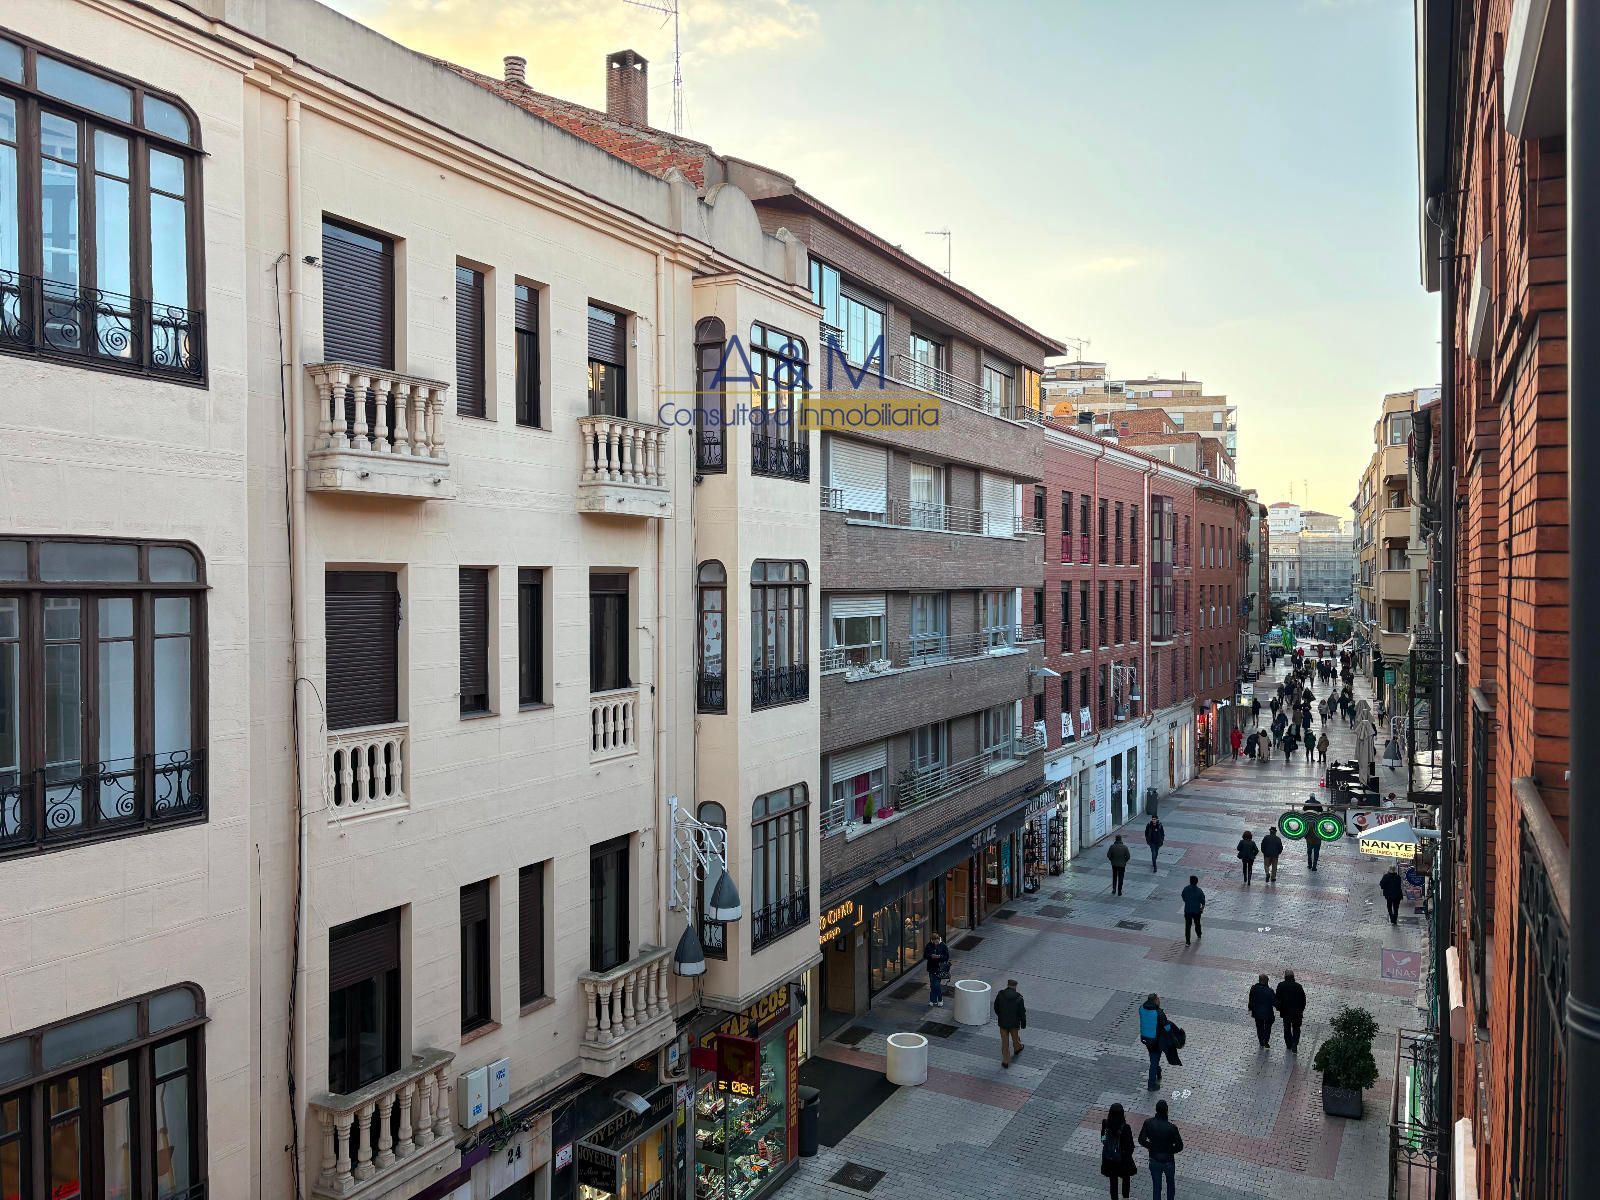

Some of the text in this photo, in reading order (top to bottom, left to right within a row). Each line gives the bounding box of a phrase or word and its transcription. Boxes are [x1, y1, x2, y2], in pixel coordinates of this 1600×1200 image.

[720, 985, 787, 1037] TABACOS
[789, 1046, 797, 1128] TABACOS
[507, 1144, 521, 1166] 24
